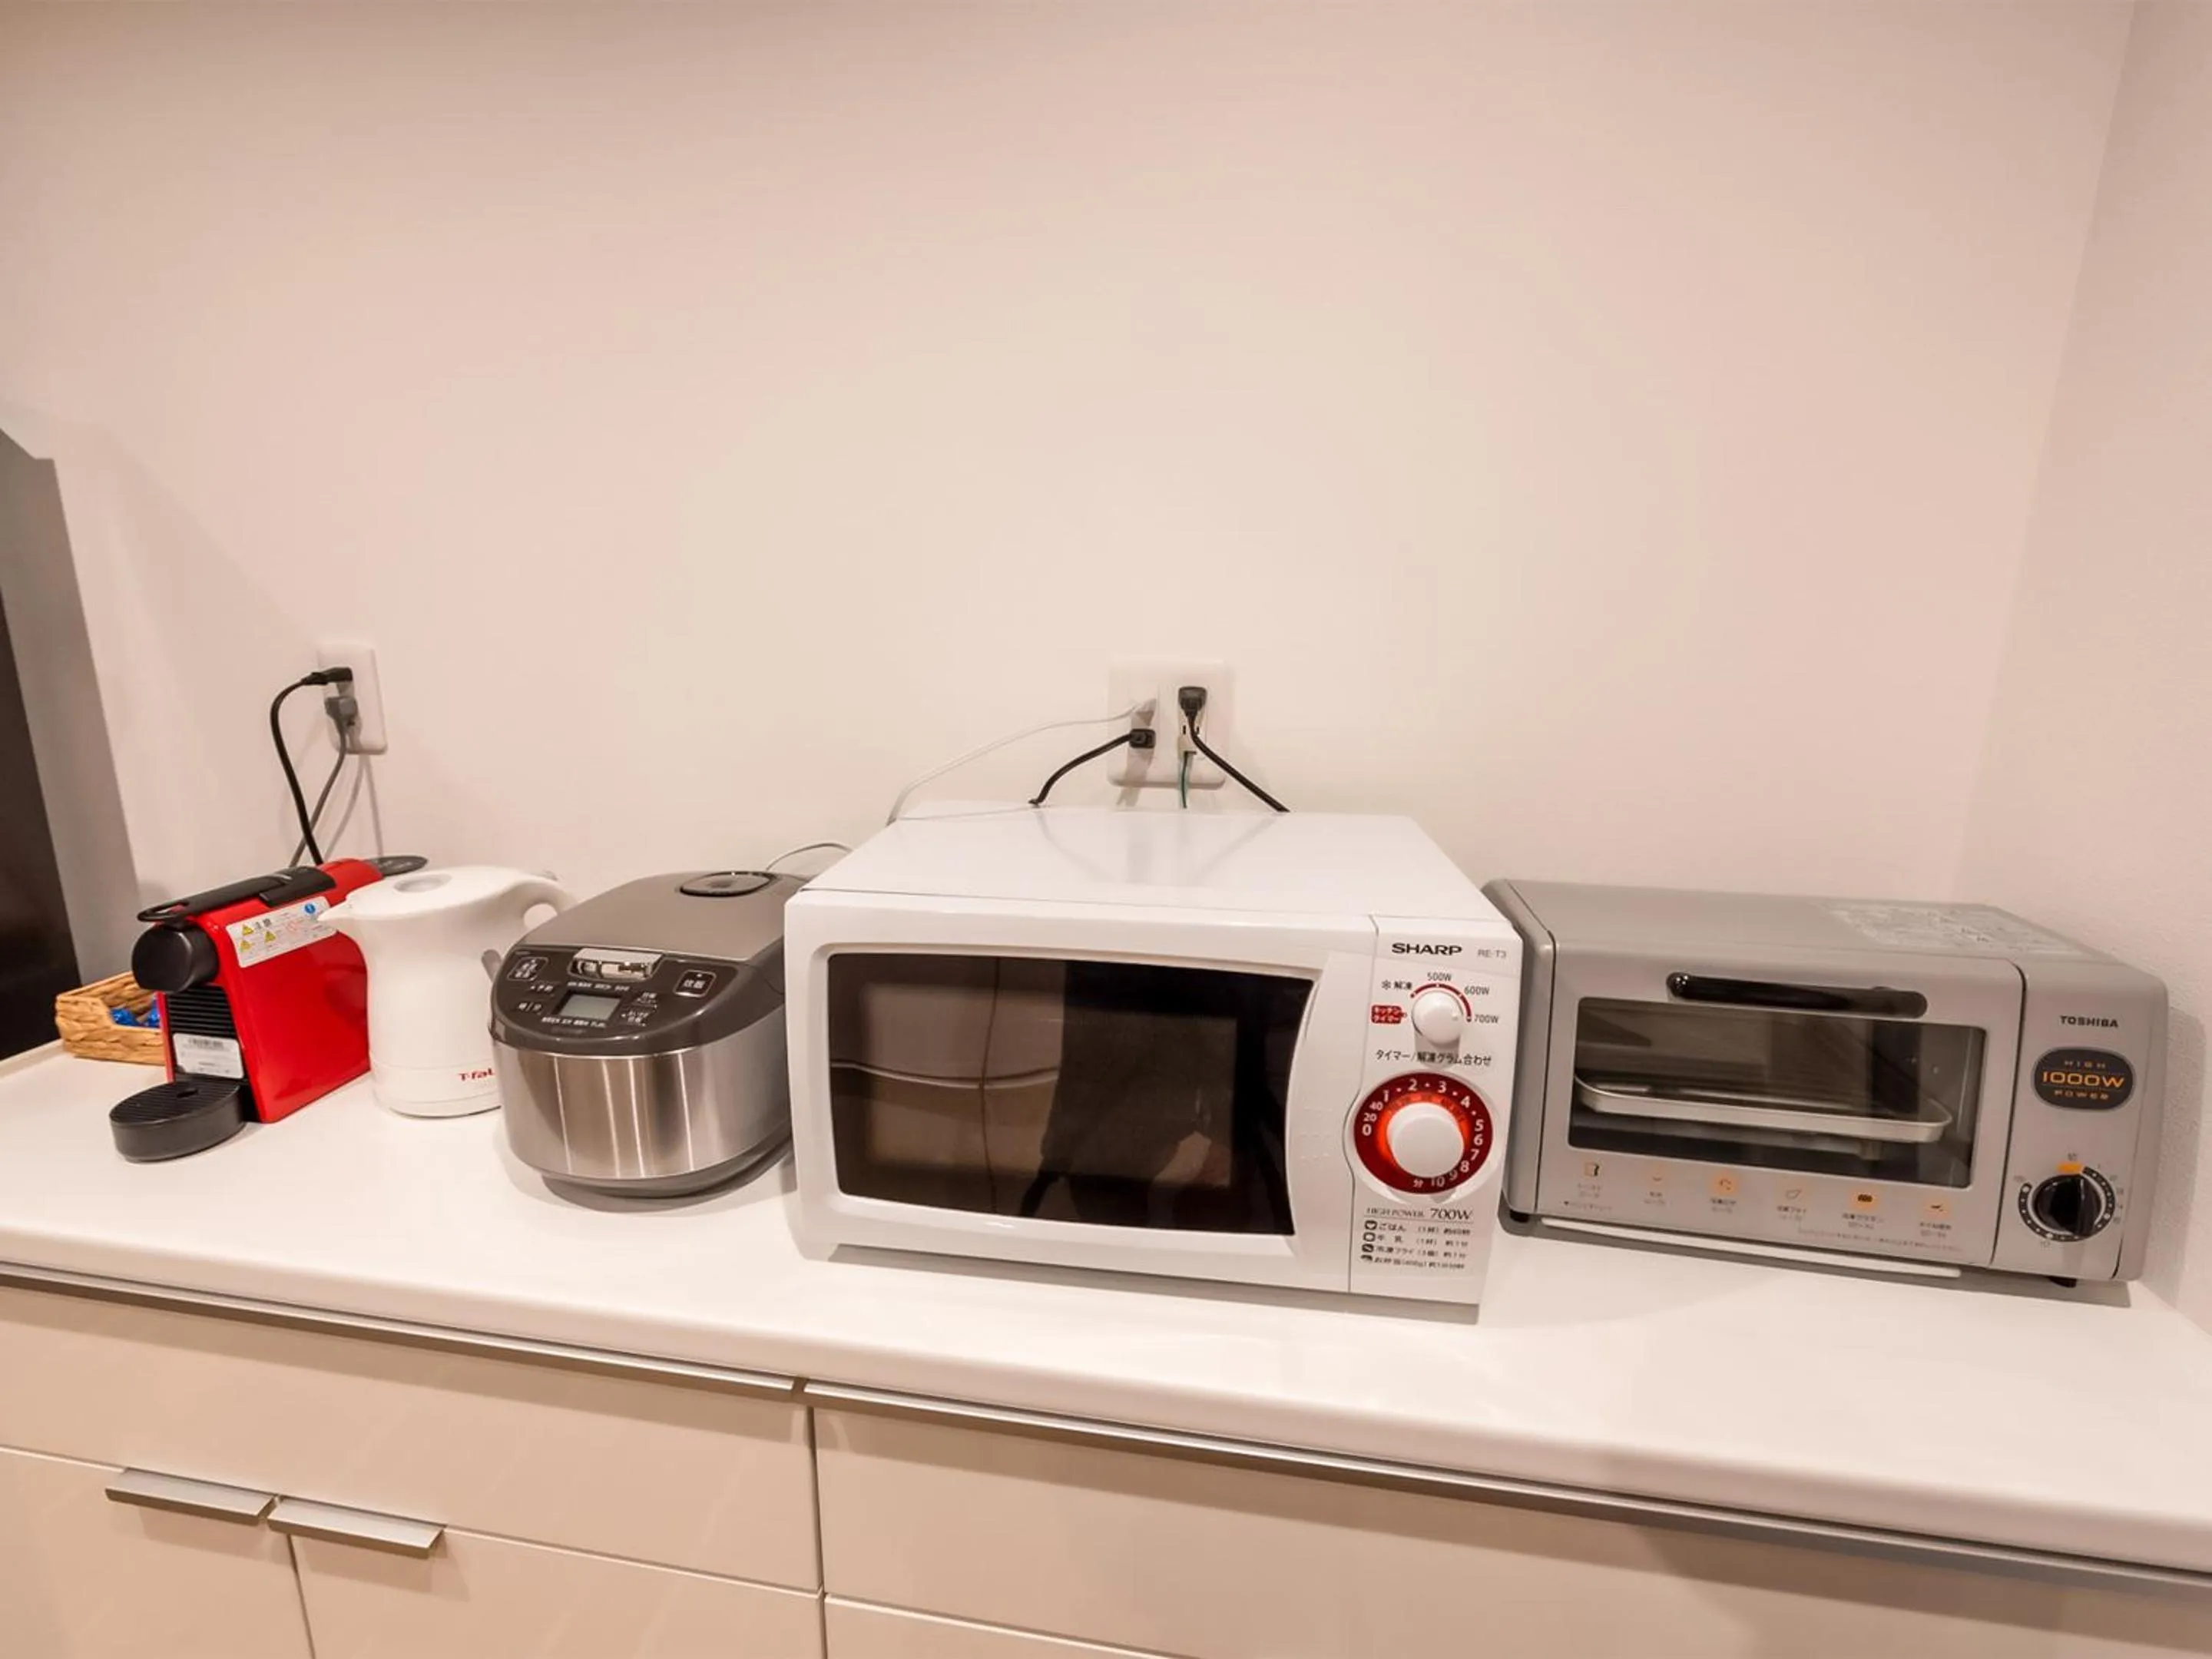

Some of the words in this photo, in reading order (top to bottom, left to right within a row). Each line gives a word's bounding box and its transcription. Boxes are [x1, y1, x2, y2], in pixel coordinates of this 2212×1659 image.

[1392, 942, 1462, 955] SHARP
[1478, 949, 1507, 959] RE-T3
[1427, 972, 1452, 982] 500W
[1464, 986, 1489, 995] 600W
[1474, 1014, 1499, 1024] 700W
[2060, 1015, 2118, 1028] TOSHIBA
[2064, 1060, 2106, 1068] HIGH
[1408, 1078, 1417, 1091] 2
[2042, 1071, 2125, 1088] 1000W
[1438, 1081, 1447, 1094] 3
[2055, 1090, 2109, 1100] POWER
[1369, 1101, 1383, 1111] 40
[1460, 1095, 1471, 1108] 4
[1363, 1113, 1377, 1122] 20
[1362, 1124, 1372, 1136] 0
[1475, 1119, 1484, 1132] 5
[1474, 1134, 1483, 1145] 6
[1470, 1148, 1480, 1161] 7
[1460, 1161, 1469, 1173] 8
[1430, 1176, 1445, 1187] 10
[1449, 1170, 1458, 1181] 9
[1430, 1207, 1473, 1220] 700W
